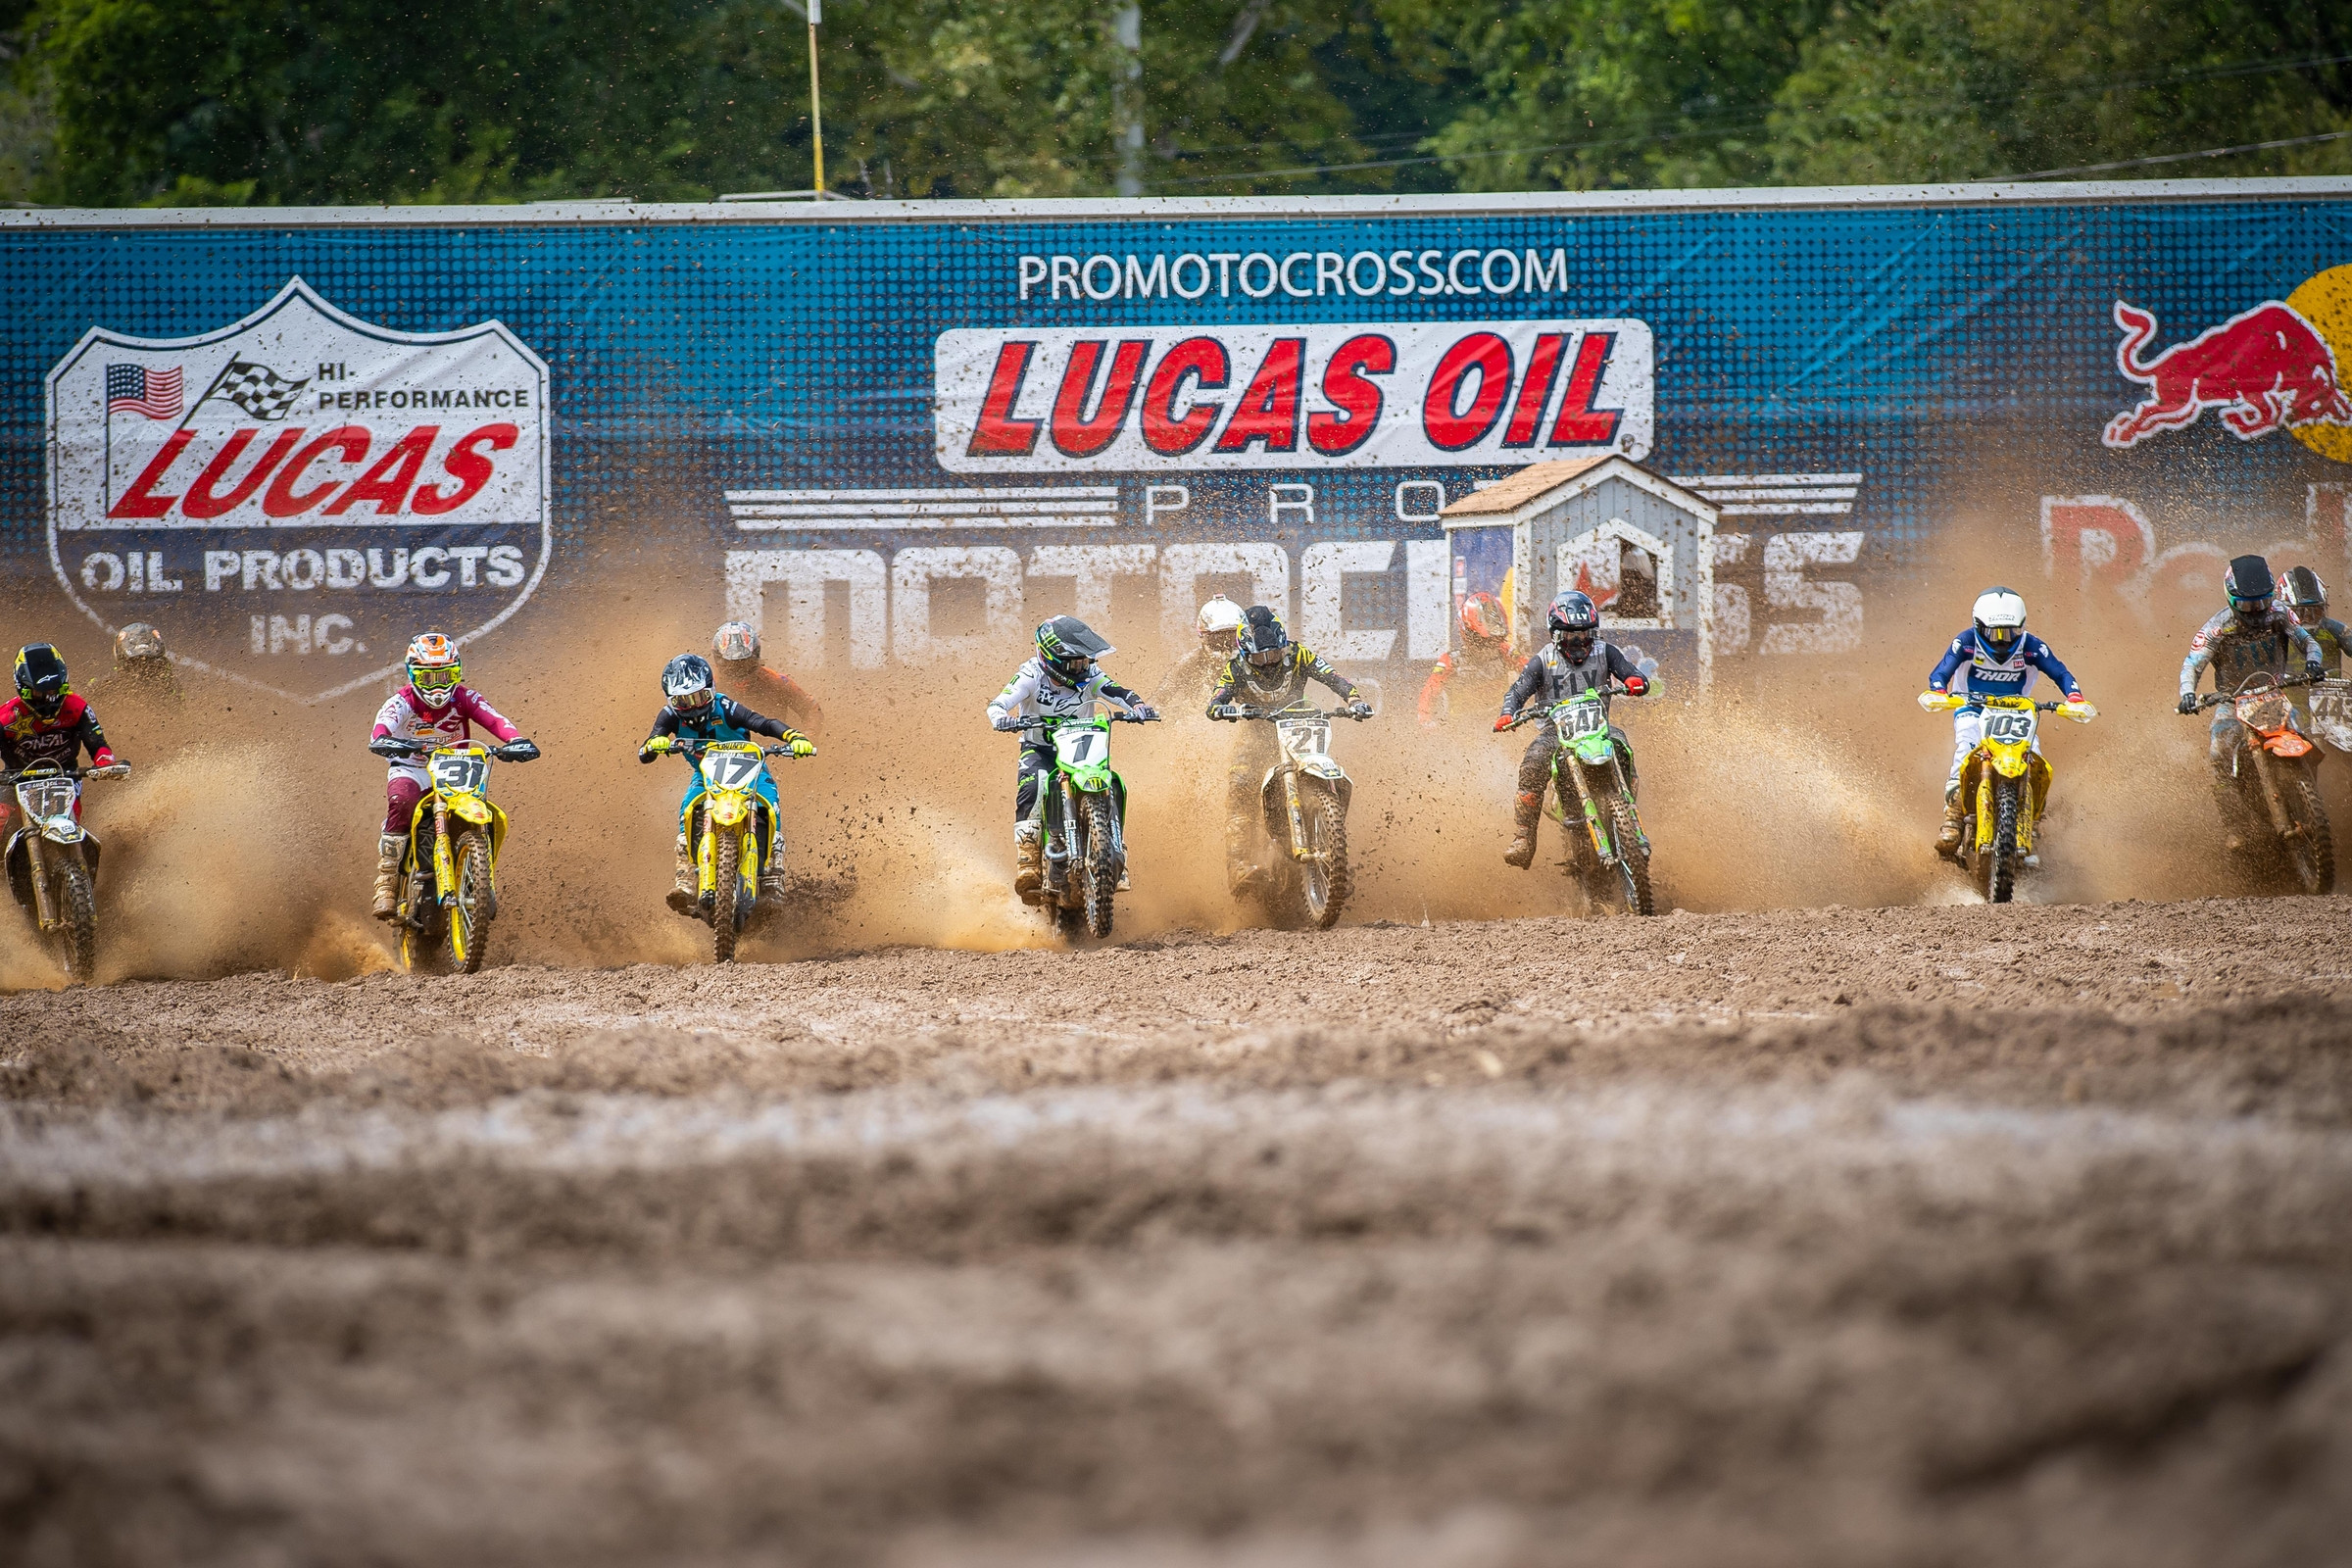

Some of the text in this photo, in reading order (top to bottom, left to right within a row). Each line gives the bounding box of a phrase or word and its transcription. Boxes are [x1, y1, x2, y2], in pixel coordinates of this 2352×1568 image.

[1018, 248, 1569, 301] PROMOTOCROSS.COM
[318, 362, 357, 382] HI-
[318, 388, 530, 411] PERFORMANCE
[966, 330, 1625, 459] LUCAS OIL
[107, 421, 519, 520] LUCAS
[80, 545, 525, 593] OIL PRODUCTS
[724, 530, 1865, 672] MOTOCS
[1569, 612, 1589, 621] FLY
[250, 612, 368, 655] INC.
[1551, 669, 1597, 699] FLY
[1974, 667, 2022, 682] THOR
[1560, 707, 1601, 741] 647
[1984, 714, 2032, 738] 103
[1071, 734, 1094, 763] 1
[1291, 727, 1326, 754] 21
[438, 760, 485, 788] 31
[712, 757, 760, 784] 17
